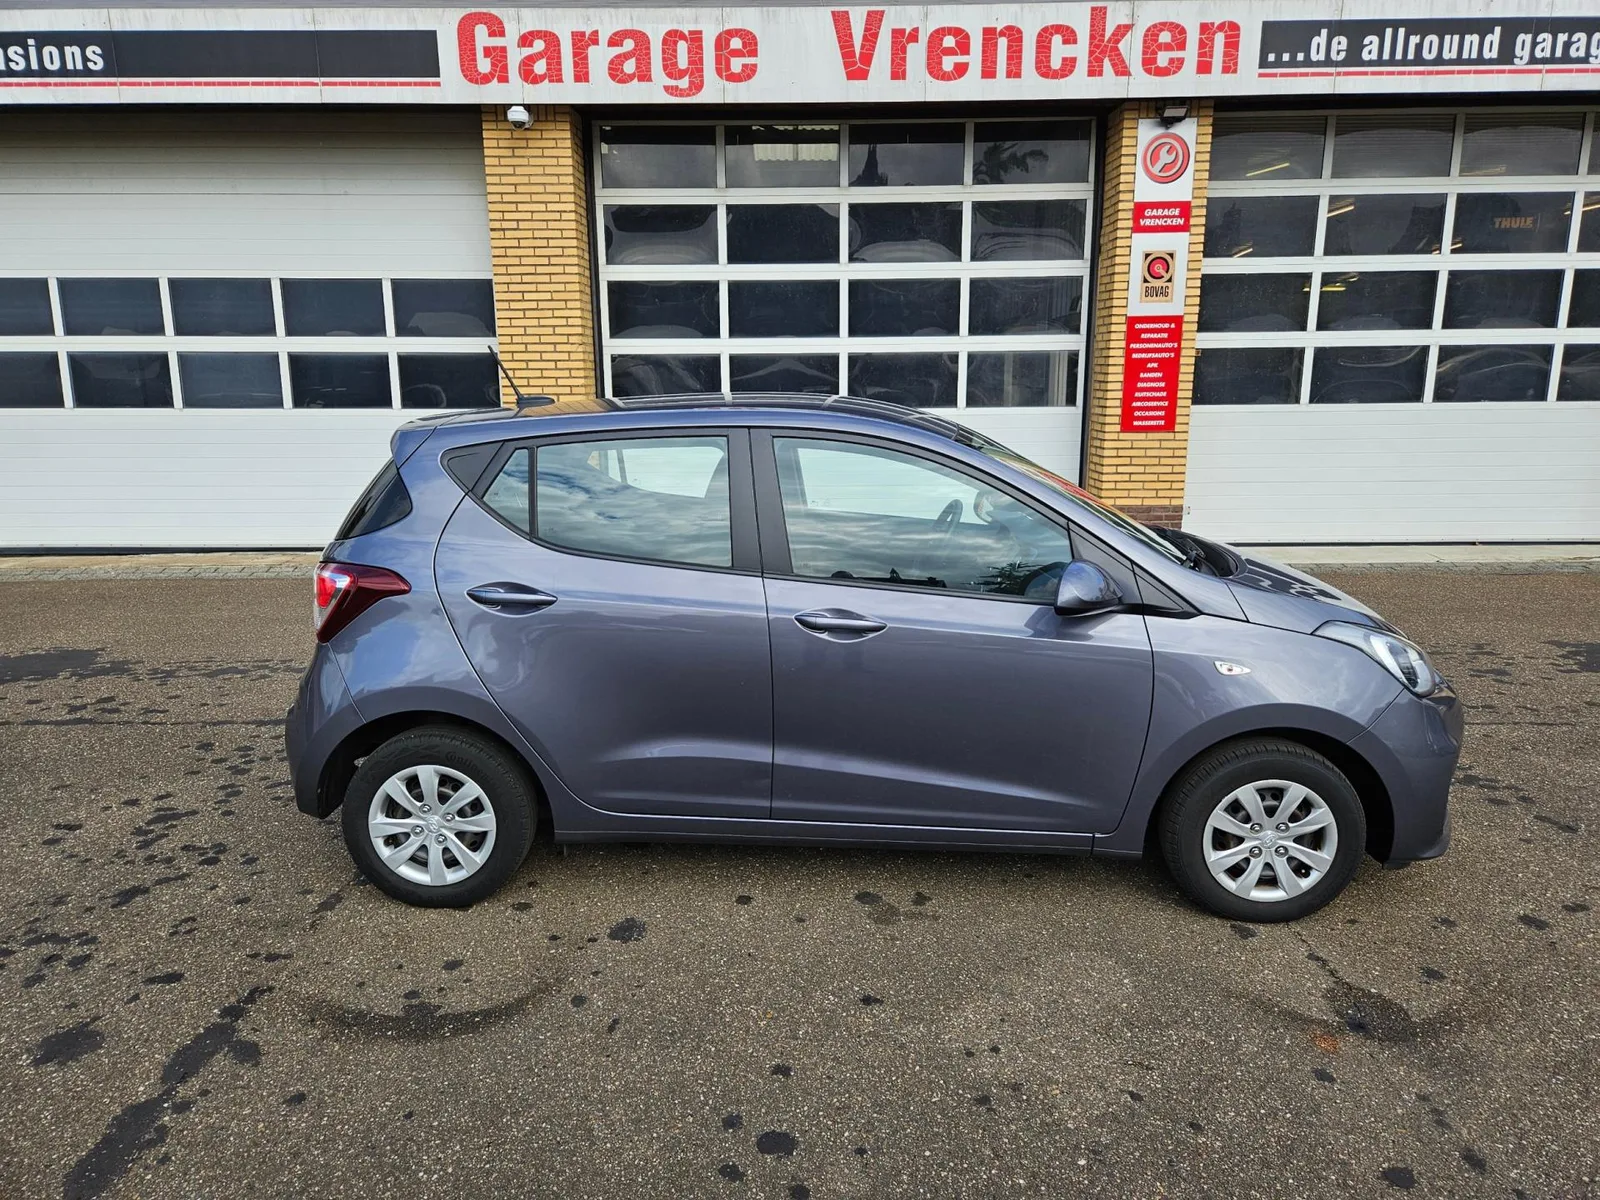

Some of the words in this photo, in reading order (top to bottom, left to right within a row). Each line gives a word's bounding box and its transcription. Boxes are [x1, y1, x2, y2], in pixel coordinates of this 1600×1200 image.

[1361, 26, 1501, 61] allround
[456, 11, 758, 98] Garage
[830, 6, 1241, 82] Vrencken
[1144, 208, 1180, 216] GARAGE
[1140, 218, 1184, 226] VRENCKEN
[1493, 217, 1533, 228] THULE
[1144, 286, 1169, 298] BOVAG
